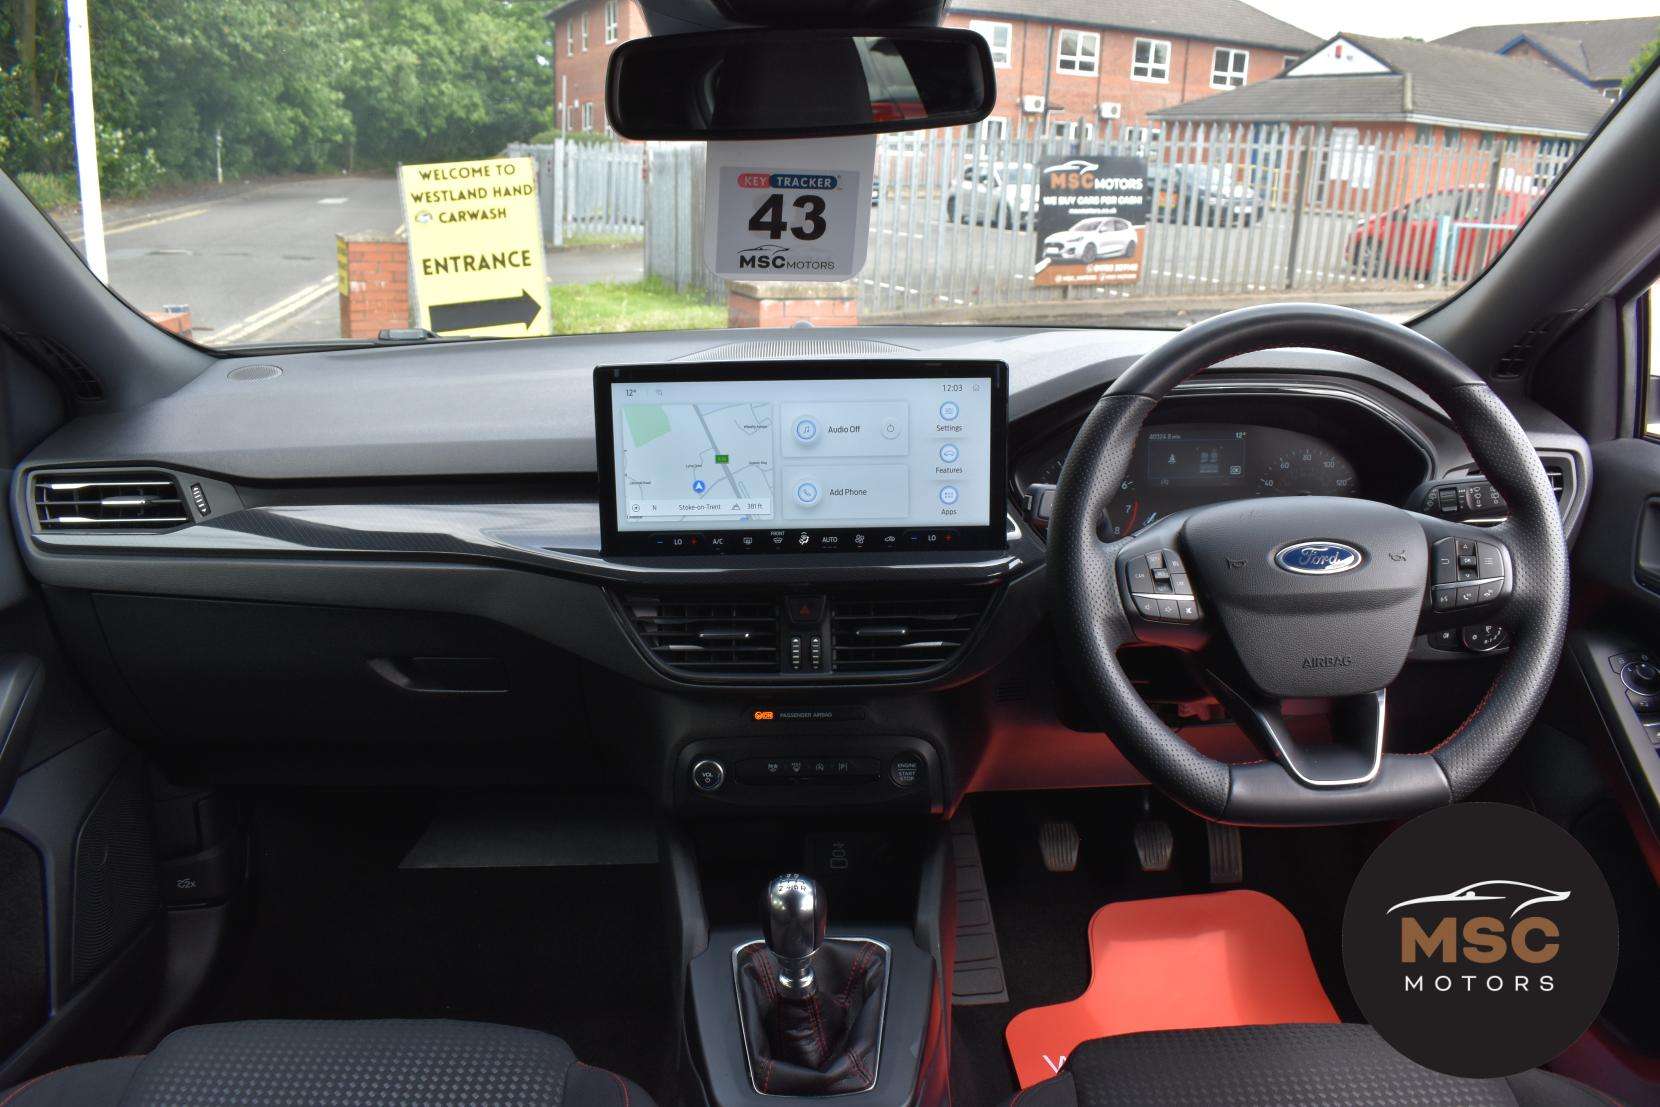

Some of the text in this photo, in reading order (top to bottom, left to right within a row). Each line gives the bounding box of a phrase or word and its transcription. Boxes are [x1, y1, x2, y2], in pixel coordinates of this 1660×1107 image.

[419, 164, 516, 181] WELCOME TO
[744, 175, 832, 188] KEY TRACKER
[1050, 172, 1144, 190] MSC MOTORS
[411, 184, 534, 203] WESTLAND HAND
[438, 208, 507, 224] CARWASH
[748, 193, 827, 241] 43
[422, 250, 532, 276] ENTRANCE
[739, 255, 835, 270] MSC MOTORS
[942, 384, 963, 392] 12:03
[828, 425, 860, 434] Audio Off
[936, 424, 963, 433] Settings
[1280, 462, 1290, 470] 60
[1323, 461, 1335, 469] 100
[935, 466, 963, 474] Features
[1121, 482, 1128, 490] 6
[829, 488, 868, 496] Add Phone
[941, 507, 957, 516] Apps
[1114, 526, 1120, 534] 8
[674, 538, 683, 546] LO
[928, 534, 937, 542] LO
[1299, 547, 1341, 566] Ford
[1302, 656, 1352, 668] AIRBAG
